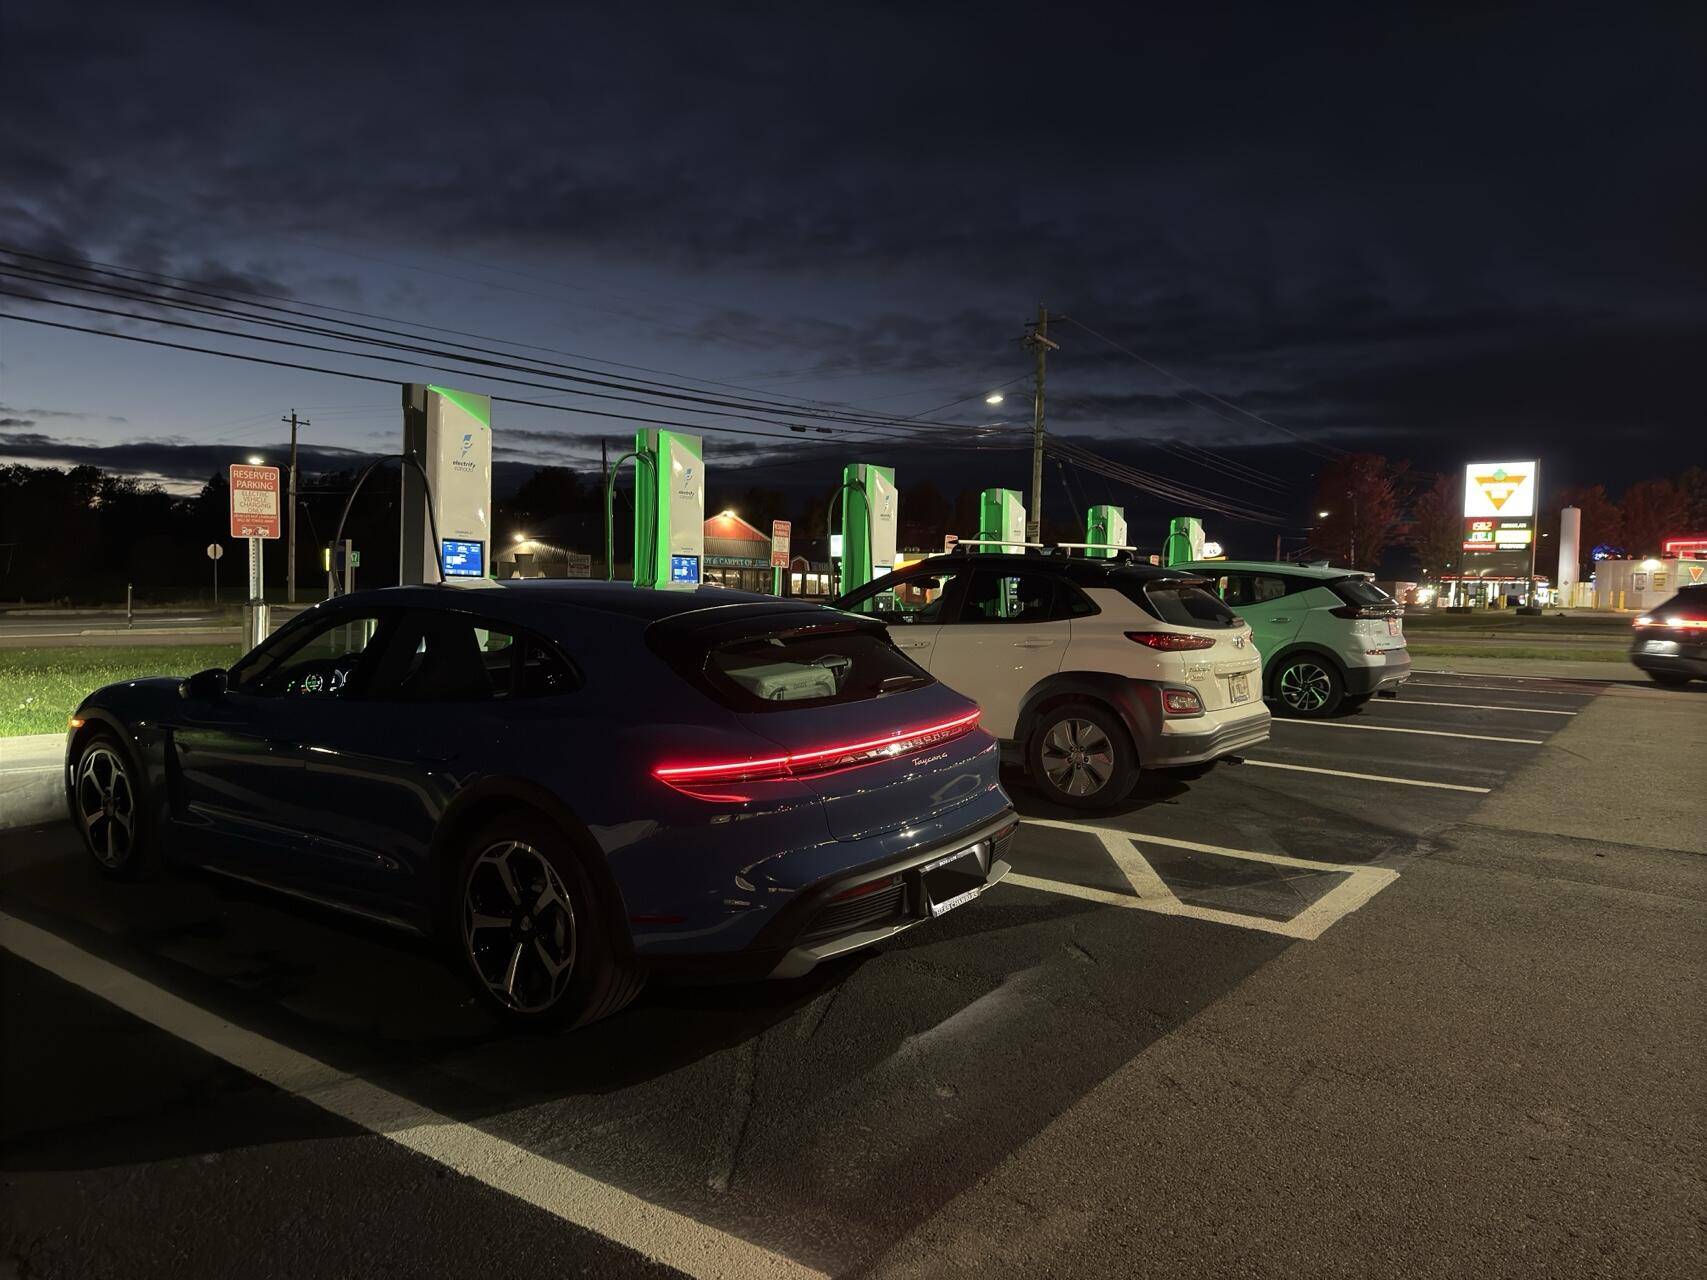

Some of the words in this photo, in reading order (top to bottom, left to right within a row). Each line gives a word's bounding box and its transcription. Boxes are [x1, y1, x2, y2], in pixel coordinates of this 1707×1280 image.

[453, 460, 475, 468] electrify
[234, 471, 276, 480] RESERVED
[236, 480, 273, 489] PARKING
[720, 558, 745, 566] CARPET
